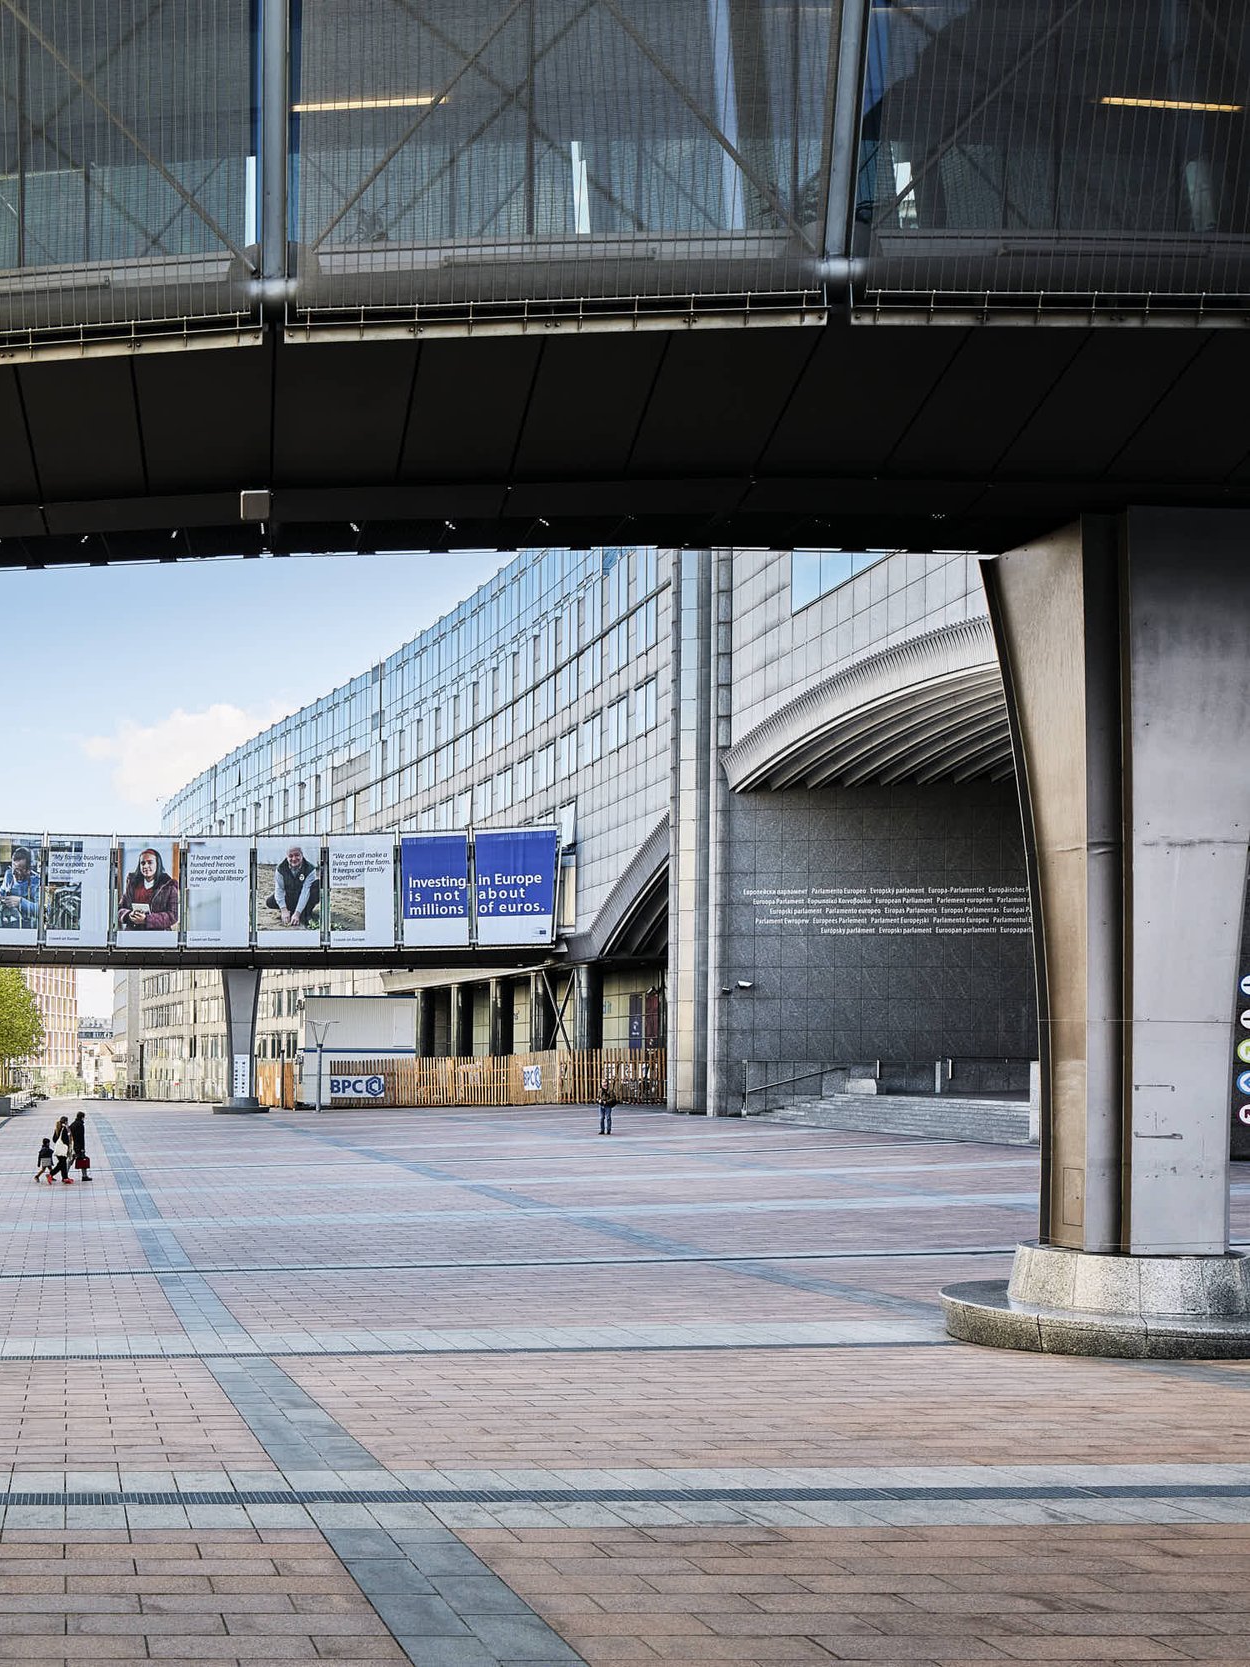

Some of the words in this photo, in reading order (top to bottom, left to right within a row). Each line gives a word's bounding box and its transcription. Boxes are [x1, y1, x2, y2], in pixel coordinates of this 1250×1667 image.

[409, 876, 466, 889] Investing
[478, 874, 490, 885] in
[495, 873, 542, 886] Europe
[410, 891, 421, 902] is
[434, 890, 460, 900] not
[479, 887, 525, 900] about
[410, 904, 464, 915] millions
[479, 901, 494, 913] of
[499, 902, 545, 912] euros.
[523, 1070, 534, 1086] BPC
[330, 1080, 363, 1093] BPC
